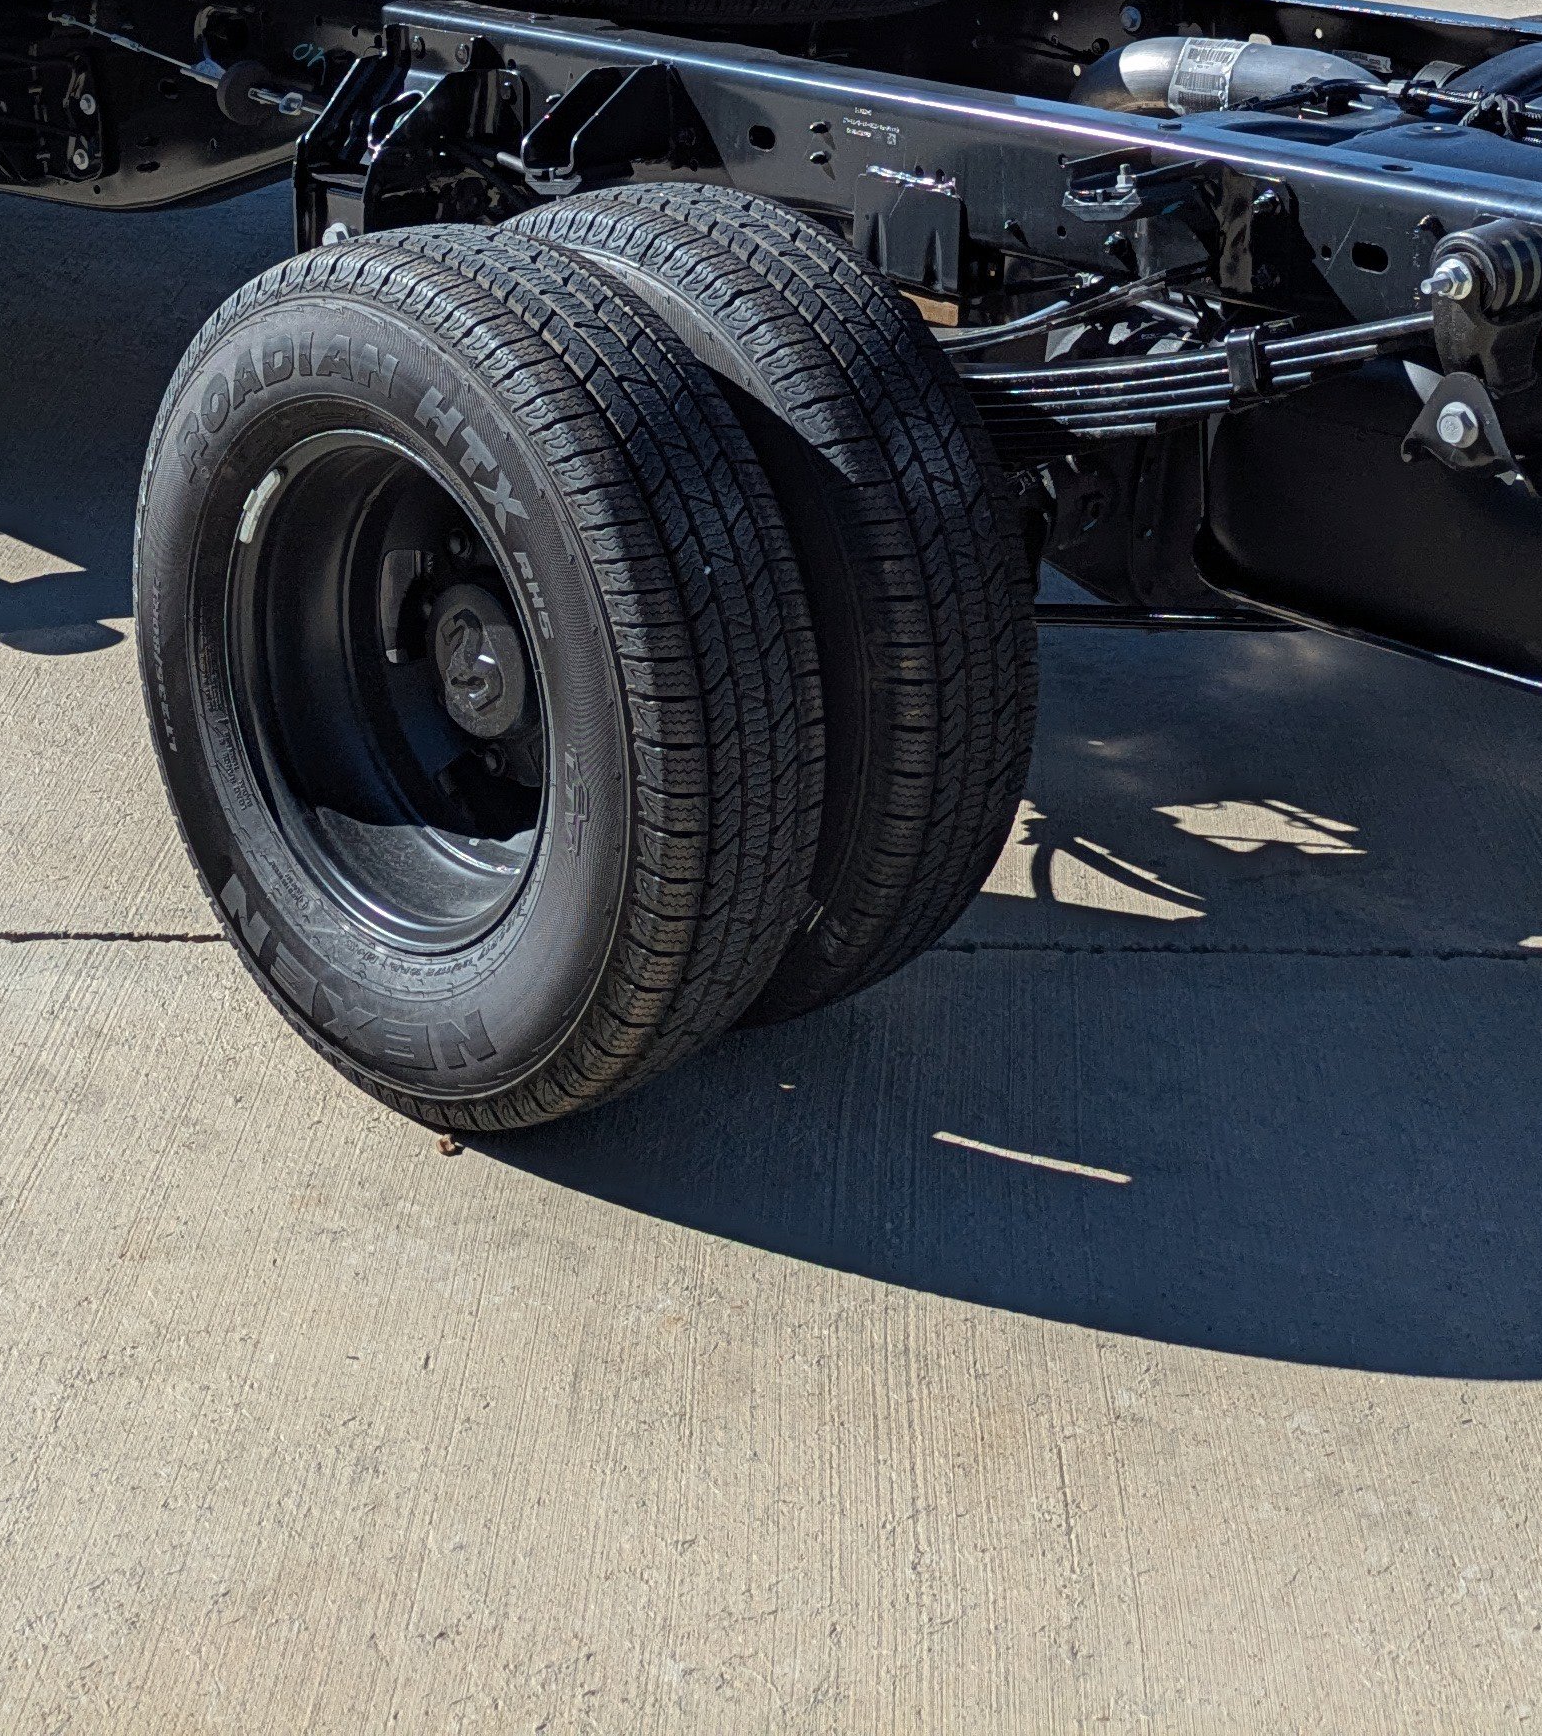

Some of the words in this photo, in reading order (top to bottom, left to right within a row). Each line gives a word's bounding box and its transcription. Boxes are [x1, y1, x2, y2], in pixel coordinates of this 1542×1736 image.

[176, 331, 400, 484] ROADIAN
[412, 385, 531, 536] HTX
[513, 551, 556, 640] RH5
[219, 873, 498, 1072] NEXEN
